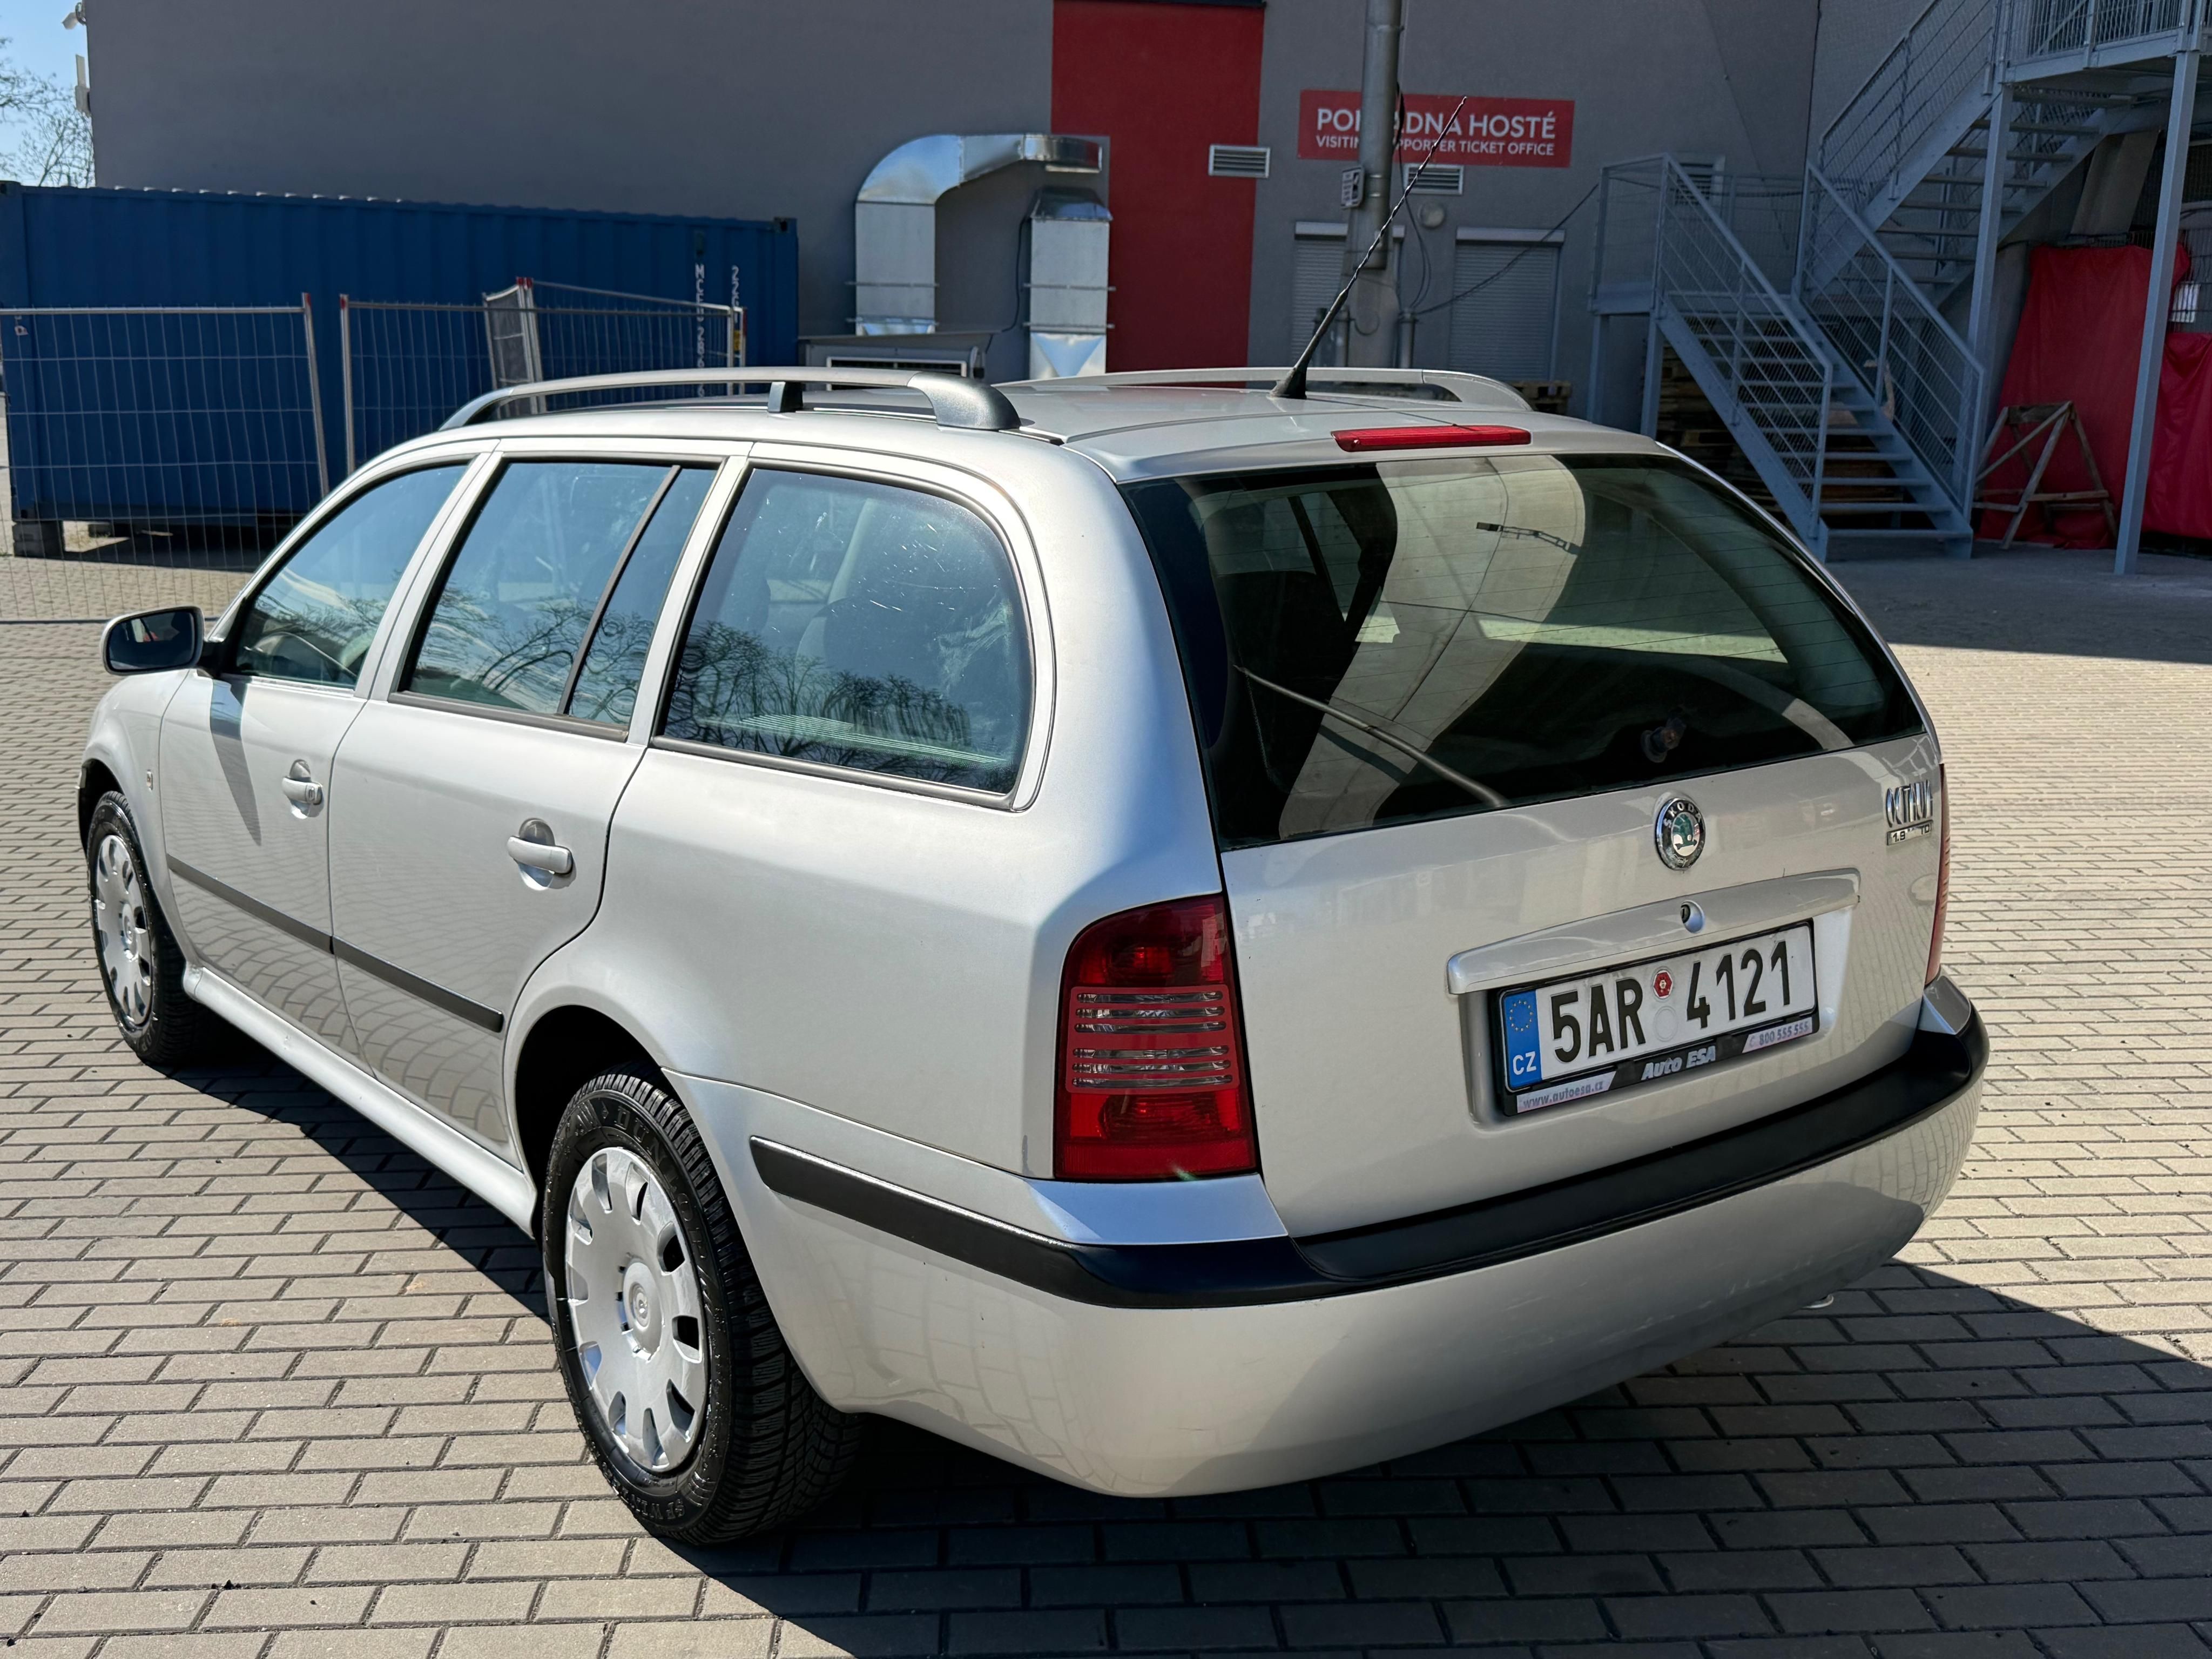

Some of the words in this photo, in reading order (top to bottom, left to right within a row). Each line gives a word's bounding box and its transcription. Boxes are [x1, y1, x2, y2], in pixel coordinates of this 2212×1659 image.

[1317, 108, 1462, 136] PODNA
[1468, 110, 1556, 139] HOSTÉ
[1459, 140, 1506, 154] TICKET
[1507, 141, 1554, 156] OFFICE
[1550, 977, 1646, 1063] 5AR
[1687, 941, 1791, 1029] 4121
[1758, 1031, 1775, 1046] 800
[1776, 1025, 1792, 1040] 555
[1793, 1020, 1809, 1036] 555
[1513, 1051, 1537, 1075] CZ
[1686, 1045, 1716, 1068] ESA
[1523, 1081, 1603, 1109] www.autoesa.cz
